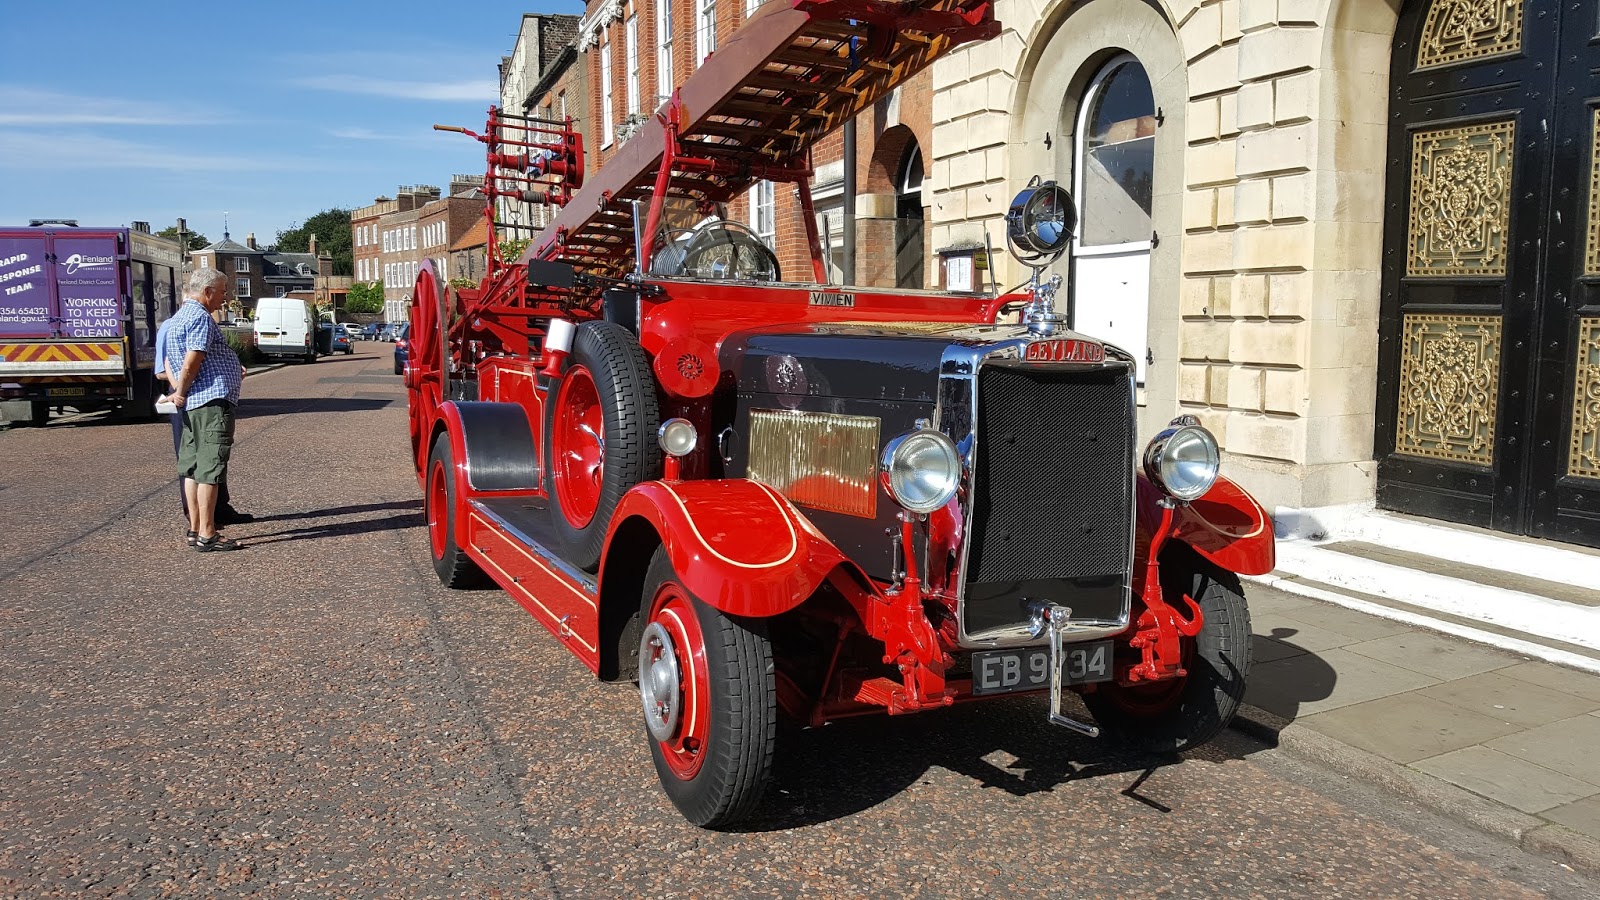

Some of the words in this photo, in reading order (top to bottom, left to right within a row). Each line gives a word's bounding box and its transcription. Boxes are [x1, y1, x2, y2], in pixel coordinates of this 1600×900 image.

[0, 253, 27, 267] RAPID
[82, 255, 113, 263] Fenland
[0, 264, 41, 283] ESPONSE
[5, 282, 33, 296] TEAM
[63, 298, 118, 307] WORKING
[0, 307, 16, 315] 354
[18, 307, 48, 315] 654321
[67, 308, 82, 317] TO
[87, 308, 116, 317] KEEP
[66, 318, 118, 328] FENLAND
[74, 329, 111, 338] CLEAN
[1026, 340, 1102, 361] LEYLAND
[981, 655, 1021, 689] EB
[1029, 646, 1107, 684] 934
